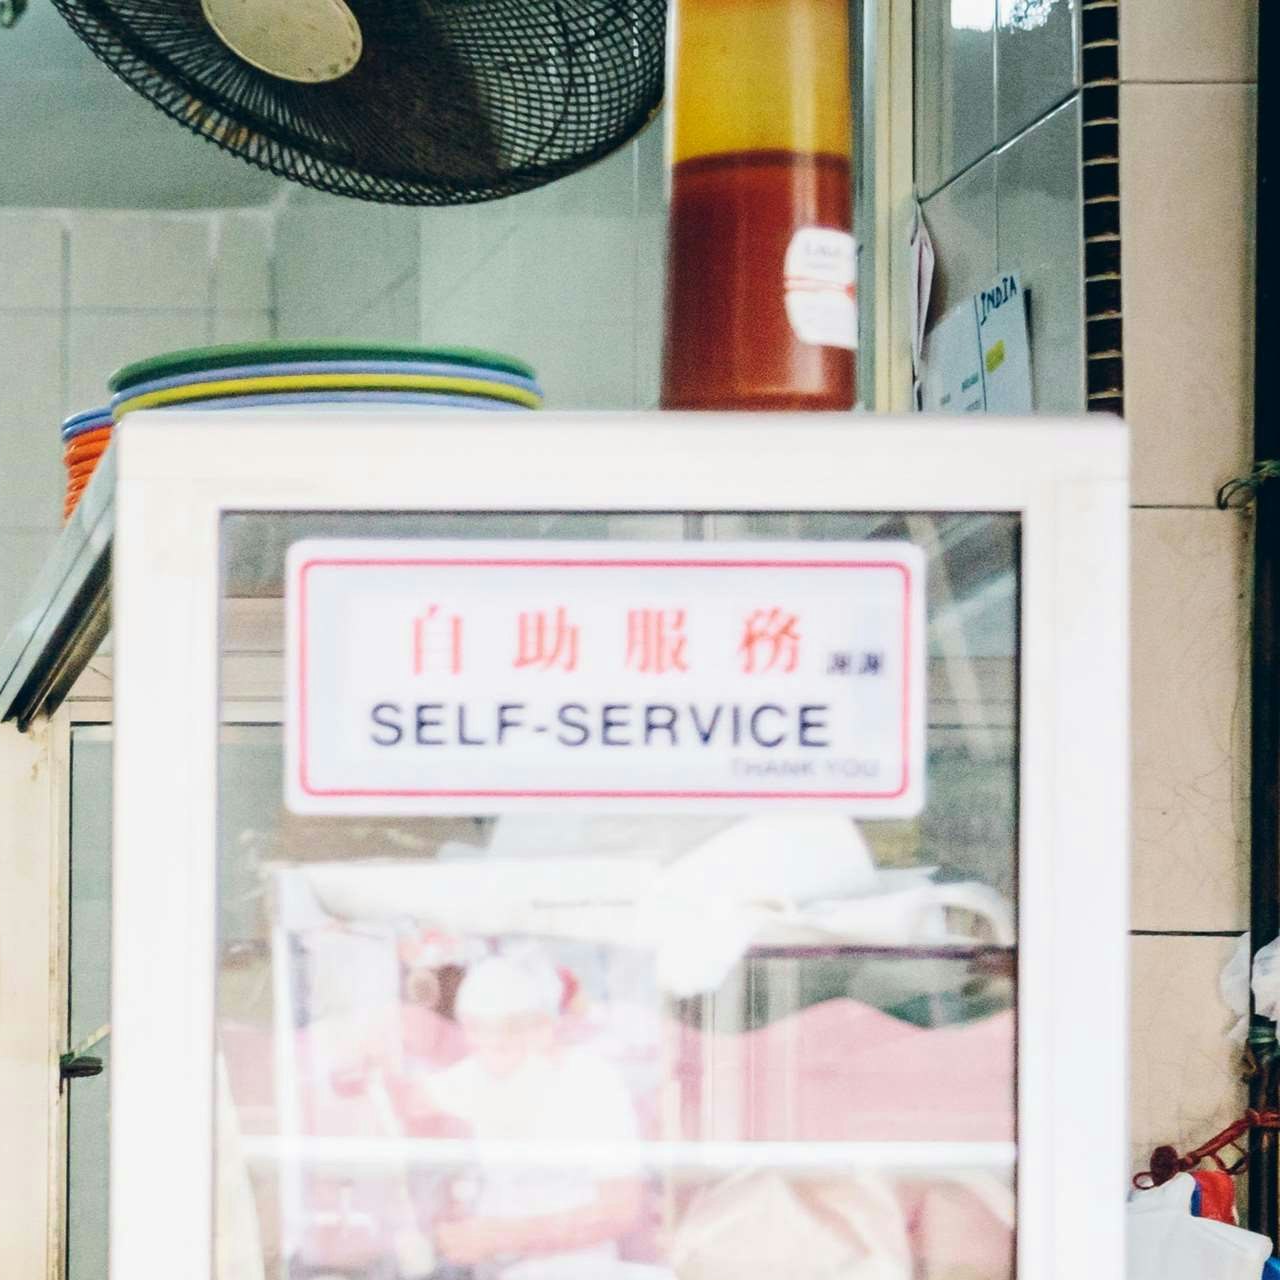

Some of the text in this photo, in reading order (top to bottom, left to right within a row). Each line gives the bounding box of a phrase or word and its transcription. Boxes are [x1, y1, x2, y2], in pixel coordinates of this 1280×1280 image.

[979, 275, 1018, 326] INDIA
[410, 605, 804, 676] 自助服務
[370, 702, 832, 748] SELF-SERVICE
[731, 757, 880, 779] THANK YOU
